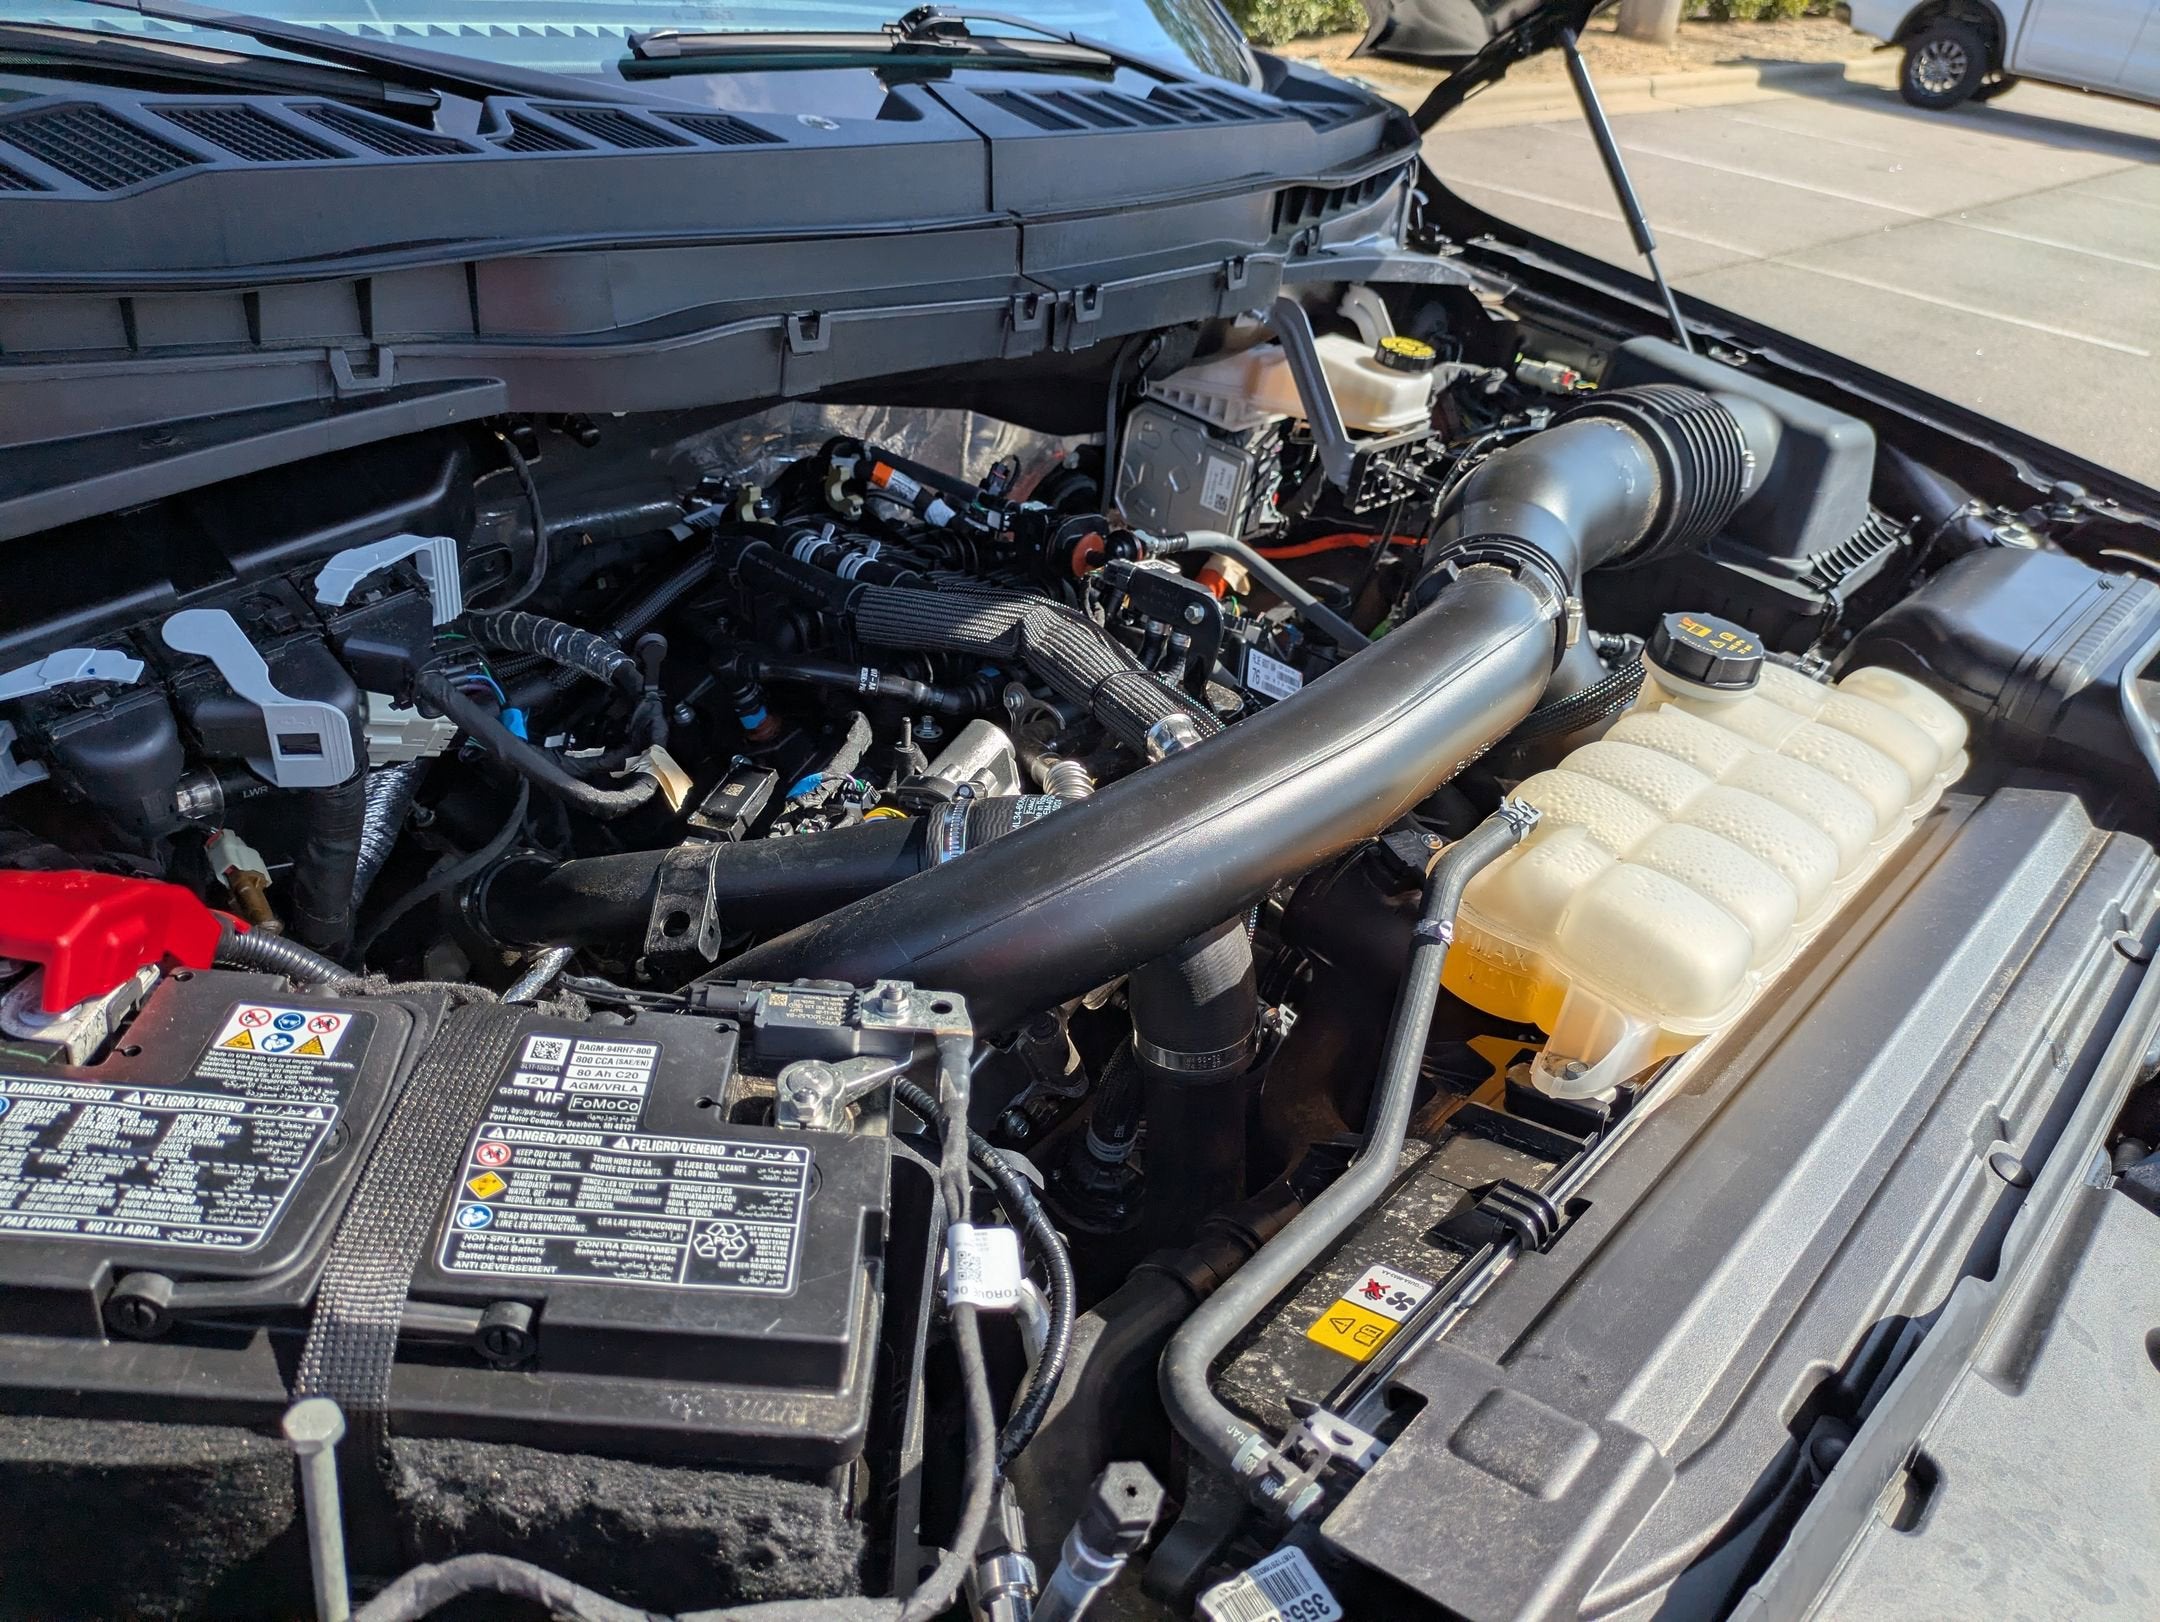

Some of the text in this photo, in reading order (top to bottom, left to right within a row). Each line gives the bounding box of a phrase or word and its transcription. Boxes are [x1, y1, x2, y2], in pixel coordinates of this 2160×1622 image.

[576, 1056, 649, 1067] 800 CCA (SAE/EN)
[577, 1069, 591, 1077] 80
[615, 1071, 639, 1079] C20
[525, 1076, 548, 1085] 12V
[7, 1082, 114, 1100] DANGER/POISON
[569, 1082, 639, 1093] AGM/VRLA
[535, 1090, 565, 1104] MF
[142, 1094, 245, 1112] PELIGRO/VENENO
[572, 1097, 639, 1111] FoMoCo
[176, 1114, 213, 1123] PROTEJA
[489, 1113, 506, 1121] Ford
[507, 1114, 529, 1123] Motor
[140, 1120, 159, 1128] GAZ
[197, 1123, 242, 1134] LOS GASES
[505, 1129, 602, 1146] DANGER/POISON
[631, 1138, 725, 1155] PELIGRO/VENENO
[534, 1150, 548, 1158] OUT
[548, 1151, 557, 1159] OF
[559, 1152, 572, 1160] THE
[593, 1154, 613, 1163] TENIR
[613, 1157, 632, 1166] HORS
[512, 1156, 535, 1165] REACH
[547, 1160, 581, 1168] CHILDREN.
[675, 1160, 747, 1173] ALÉJESE DEL ALCANCE
[168, 1164, 200, 1173] CHISPAS
[617, 1165, 631, 1174] DES
[631, 1167, 663, 1176] ENFANTS.
[673, 1168, 683, 1176] DE
[684, 1169, 697, 1177] LOS
[163, 1171, 194, 1179] FLAMAS
[513, 1172, 534, 1180] FLUSH
[159, 1179, 198, 1189] CIGARROS
[510, 1180, 571, 1191] IMMEDIATELY WITH
[582, 1177, 605, 1185] RINCEZ
[533, 1189, 546, 1197] GET
[670, 1183, 702, 1192] ENJUAGUE
[716, 1186, 733, 1195] OJOS
[504, 1195, 569, 1207] MEDICAL HELP FAST.
[577, 1192, 613, 1201] CONSULTER
[668, 1191, 737, 1203] INMEDIATAMENTE CON
[575, 1200, 585, 1208] UN
[709, 1201, 733, 1211] RÁPIDO
[665, 1206, 679, 1214] CON
[1, 1215, 78, 1230] PAS OUVRIR.
[498, 1210, 578, 1224] READ INSTRUCTIONS.
[85, 1221, 160, 1237] NO LA ABRA.
[495, 1219, 588, 1233] LIRE LES INSTRUCTIONS.
[597, 1217, 689, 1232] LEA LAS INSTRUCCIONES.
[463, 1233, 545, 1245] NON-SPILLABLE
[714, 1236, 729, 1245] Pb
[460, 1241, 546, 1256] Lead Acid Battery
[576, 1240, 677, 1254] CONTRA DERRAMES
[457, 1251, 495, 1260] Batterie
[619, 1250, 645, 1259] plomo
[453, 1260, 558, 1274] ANTI DÉVERSEMENT
